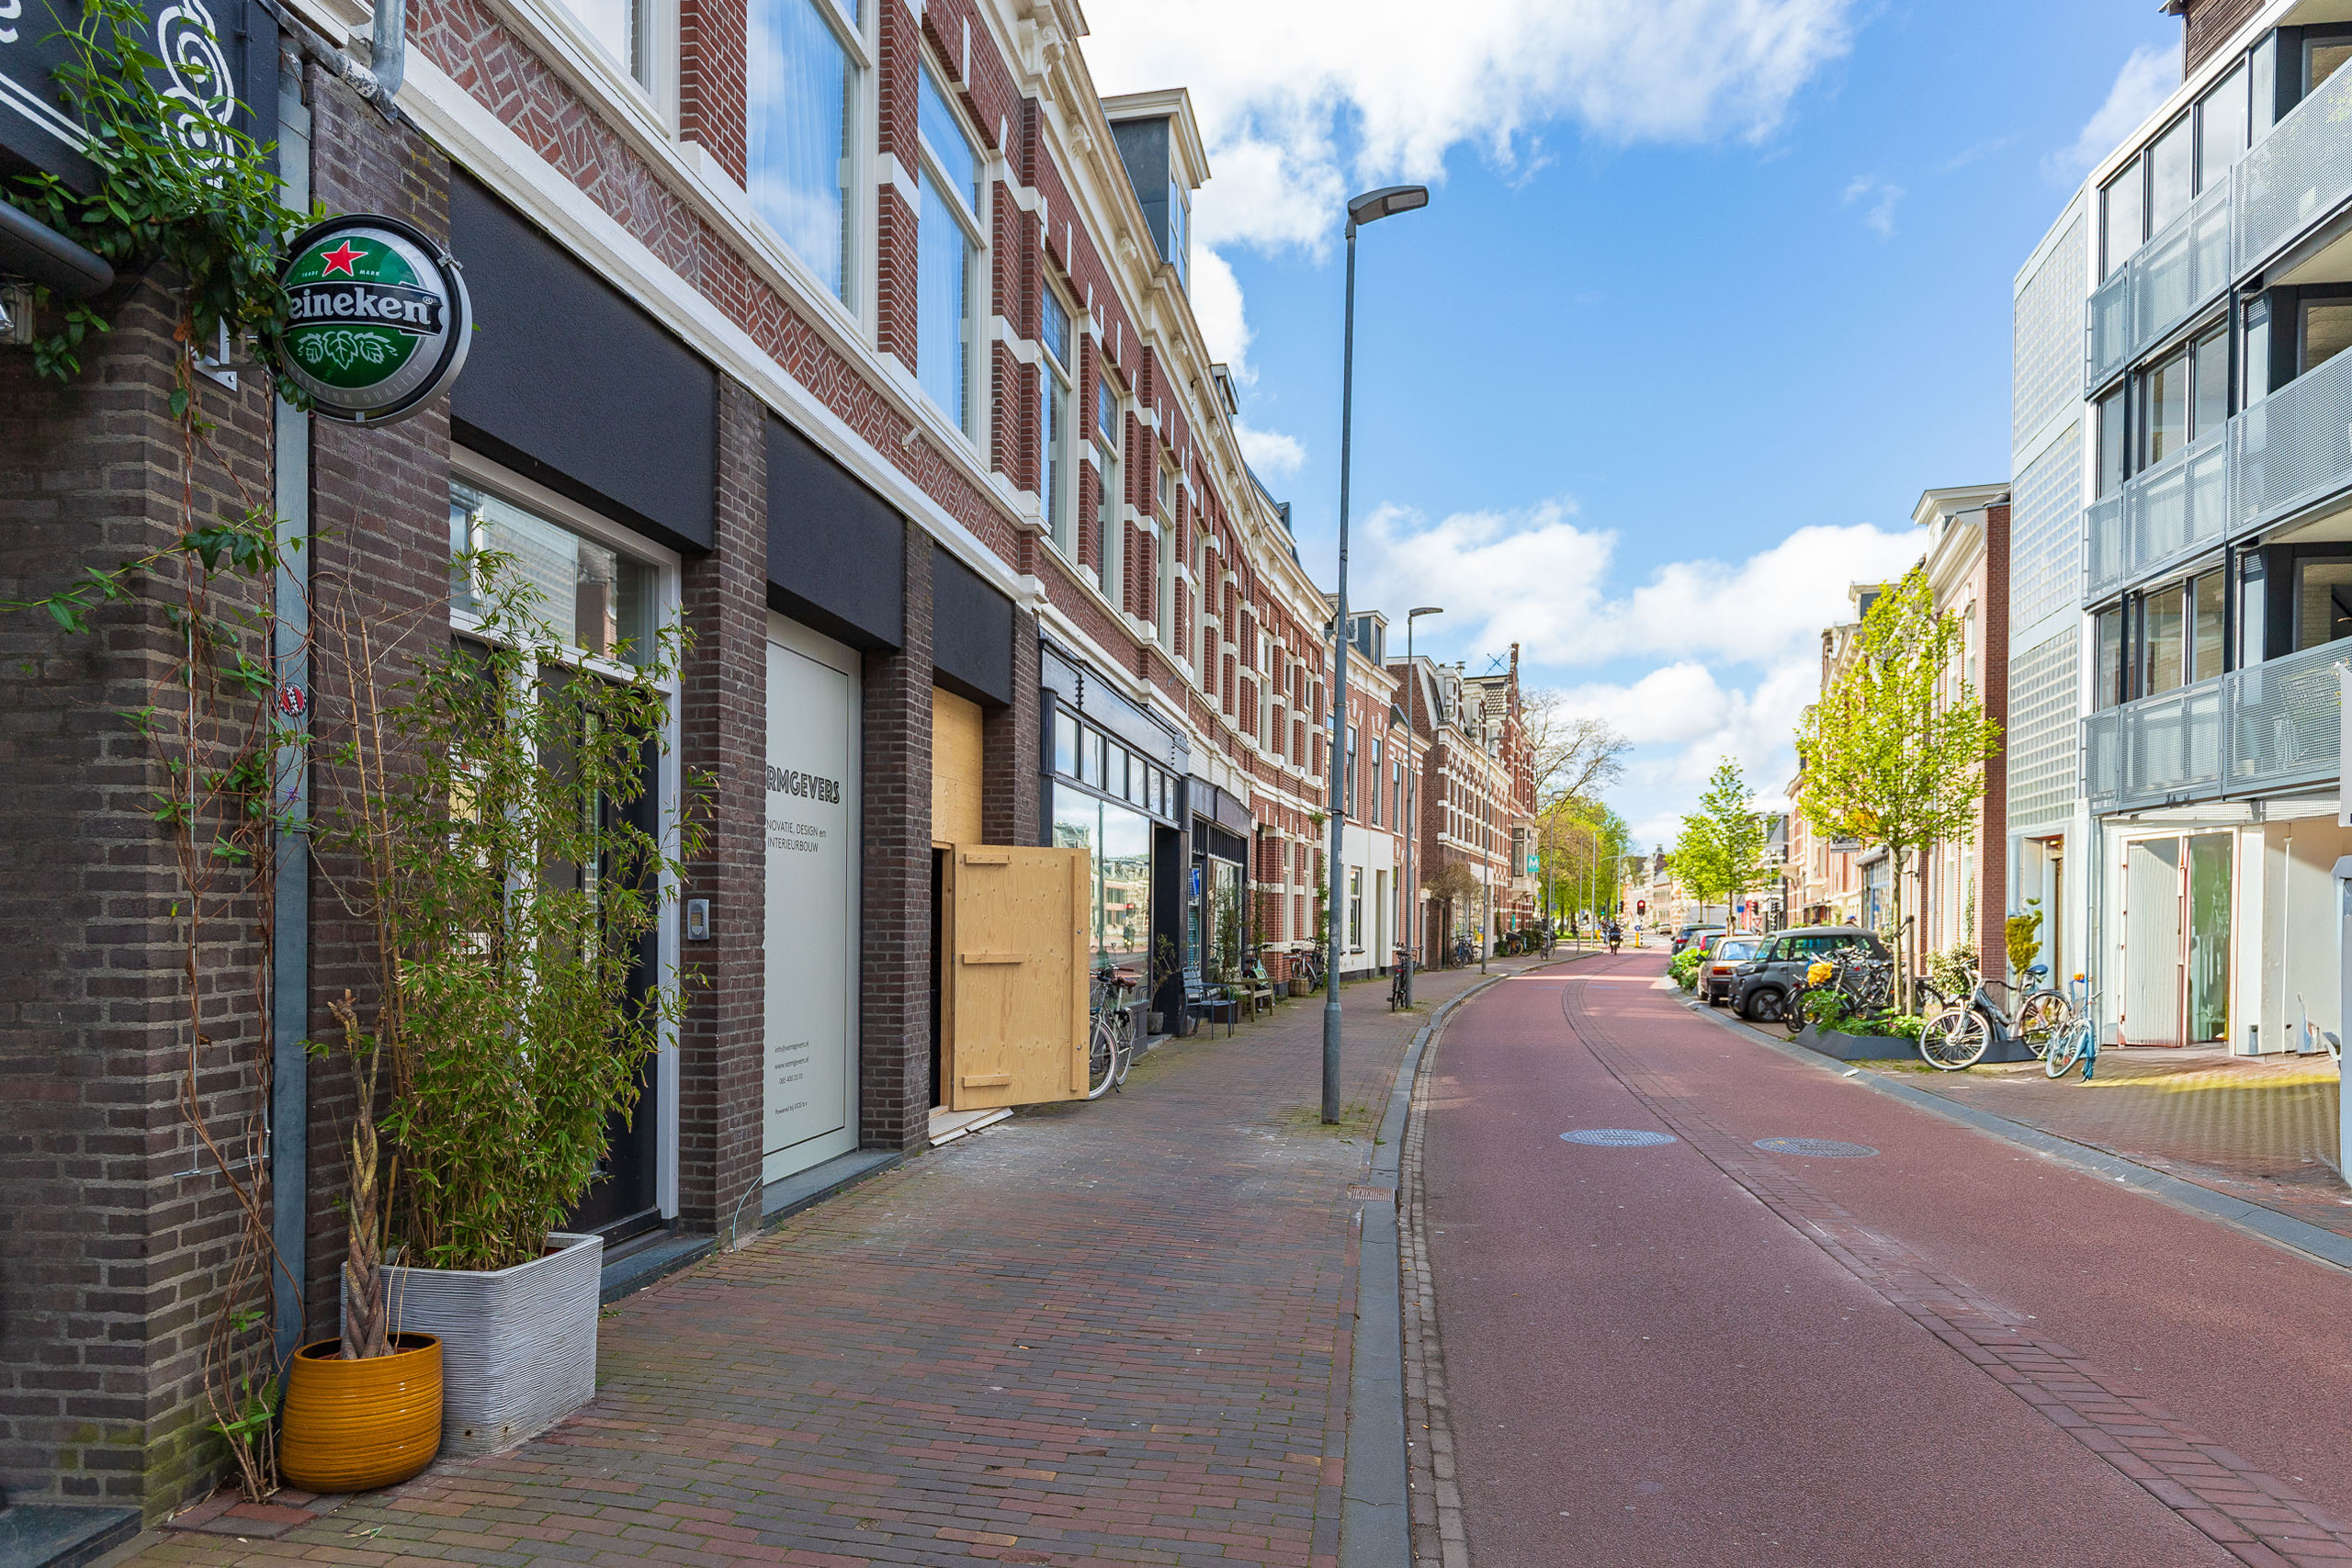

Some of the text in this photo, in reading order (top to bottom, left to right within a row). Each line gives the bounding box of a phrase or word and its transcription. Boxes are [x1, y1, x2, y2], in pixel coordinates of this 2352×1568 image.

[288, 287, 431, 325] eineken
[363, 364, 424, 404] QUALITY
[766, 764, 840, 804] RMGEVERS
[766, 819, 827, 838] NOVATIE, DESIGN en
[767, 837, 819, 852] INTERIEURBOUW
